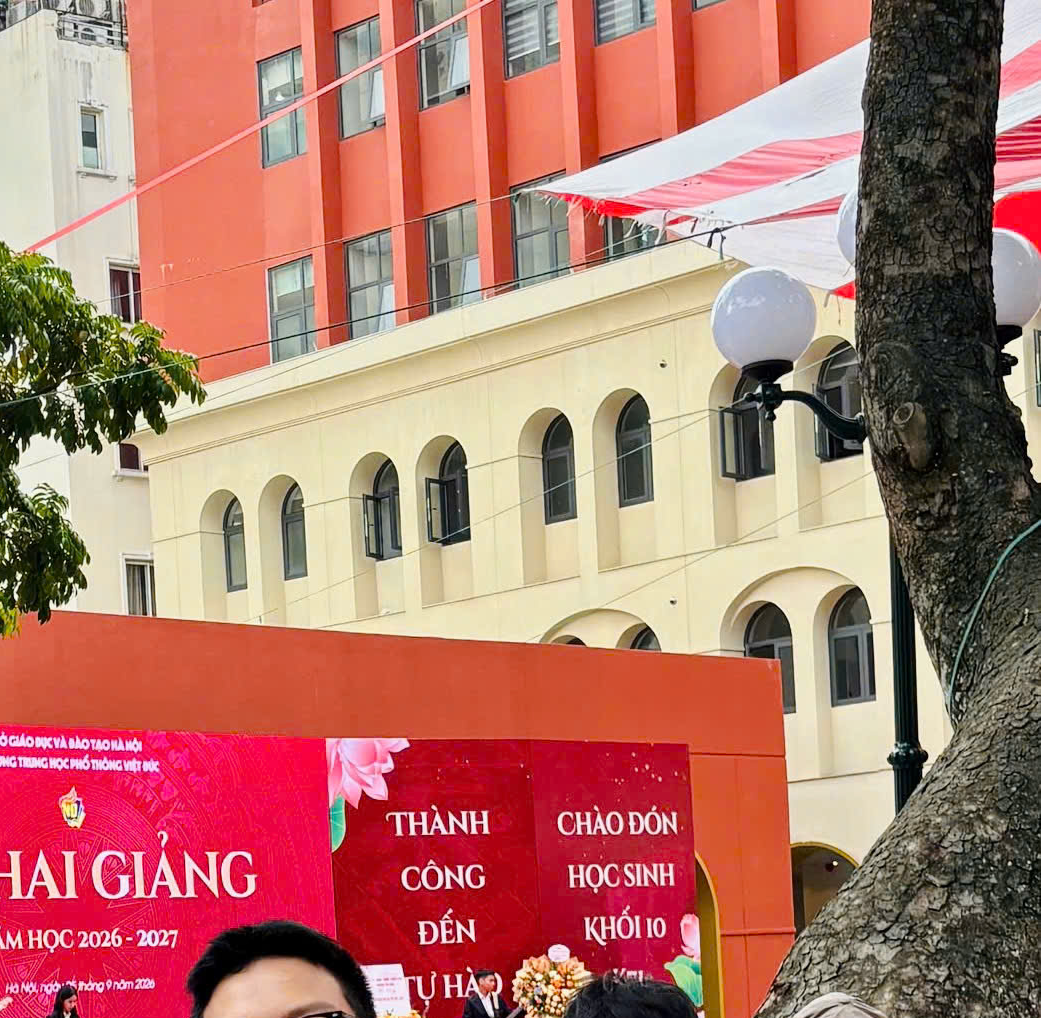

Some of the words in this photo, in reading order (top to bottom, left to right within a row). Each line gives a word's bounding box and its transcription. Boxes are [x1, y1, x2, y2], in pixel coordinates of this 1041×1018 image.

[386, 804, 490, 837] THÀNH
[557, 805, 624, 836] CHÀO
[628, 805, 678, 836] ĐÓN
[91, 830, 258, 900] GIẢNG
[401, 859, 486, 892] CÔNG
[568, 864, 619, 893] HỌC
[623, 862, 675, 887] SINH
[27, 929, 74, 953] HỌC
[77, 929, 122, 948] 2026
[136, 929, 178, 948] 2027
[418, 908, 476, 946] ĐẾN
[584, 905, 642, 946] KHỐI
[646, 916, 666, 939] 10
